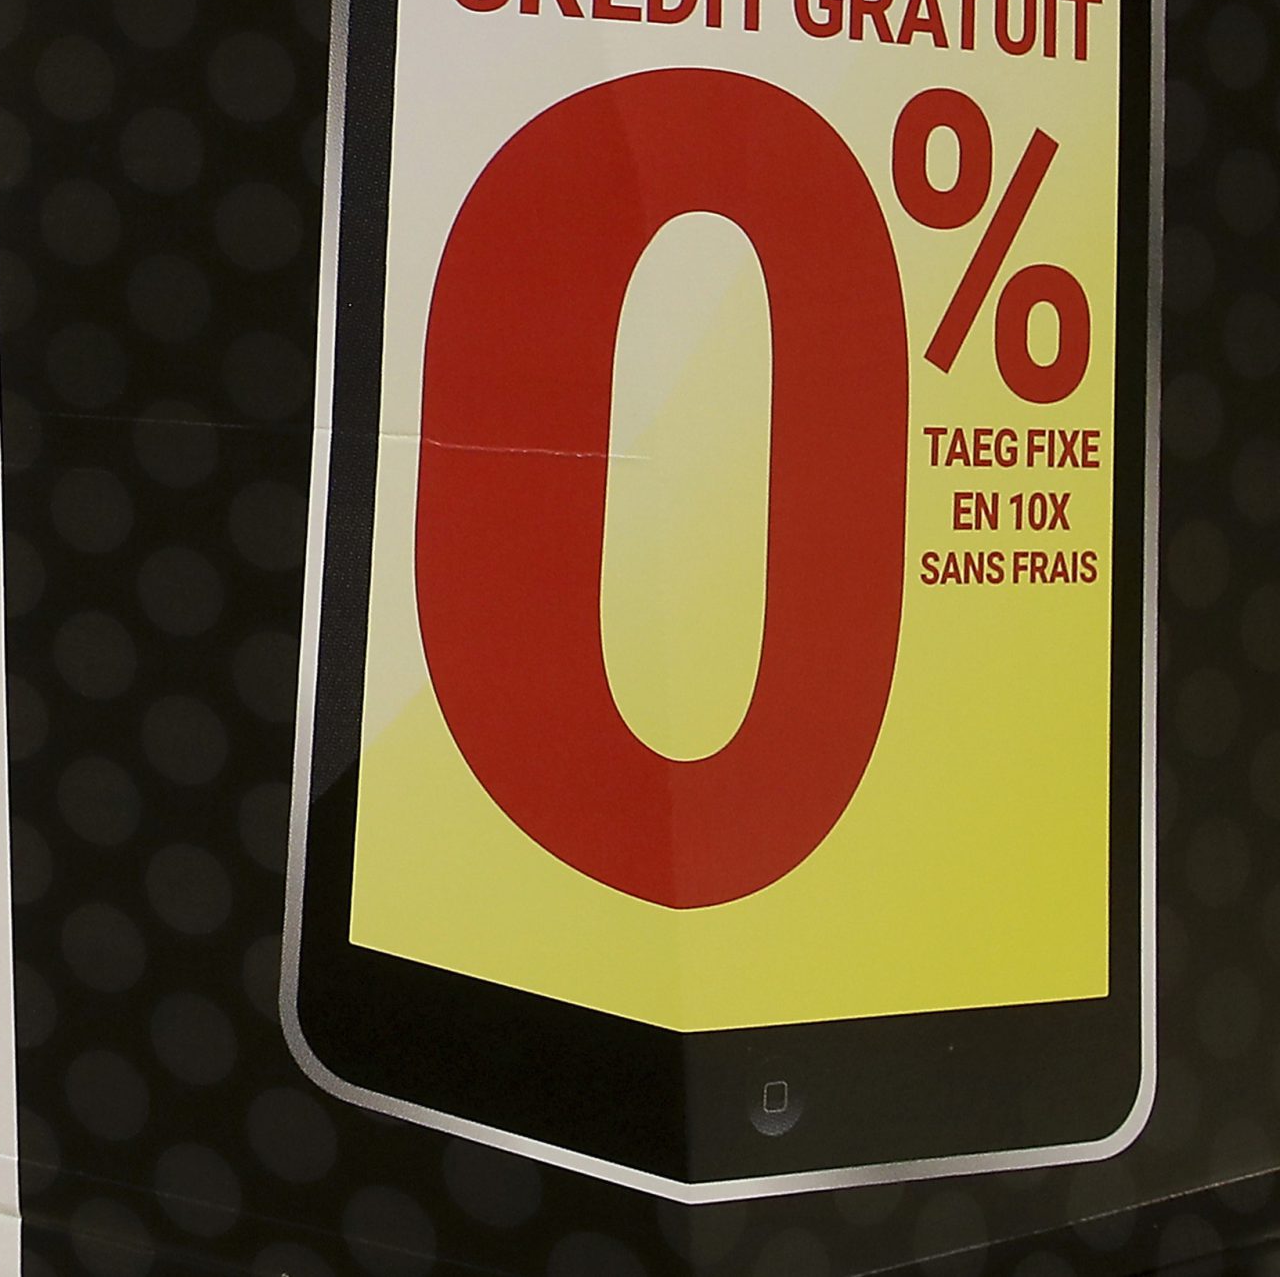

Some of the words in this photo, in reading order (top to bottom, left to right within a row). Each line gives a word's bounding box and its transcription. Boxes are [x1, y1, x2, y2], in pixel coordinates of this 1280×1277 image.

[922, 427, 1018, 468] TAEG
[1026, 428, 1101, 469] FIXE
[952, 491, 1000, 531] EN
[1009, 492, 1071, 531] 10X
[919, 551, 1006, 586] SANS
[1012, 550, 1098, 584] FRAIS
